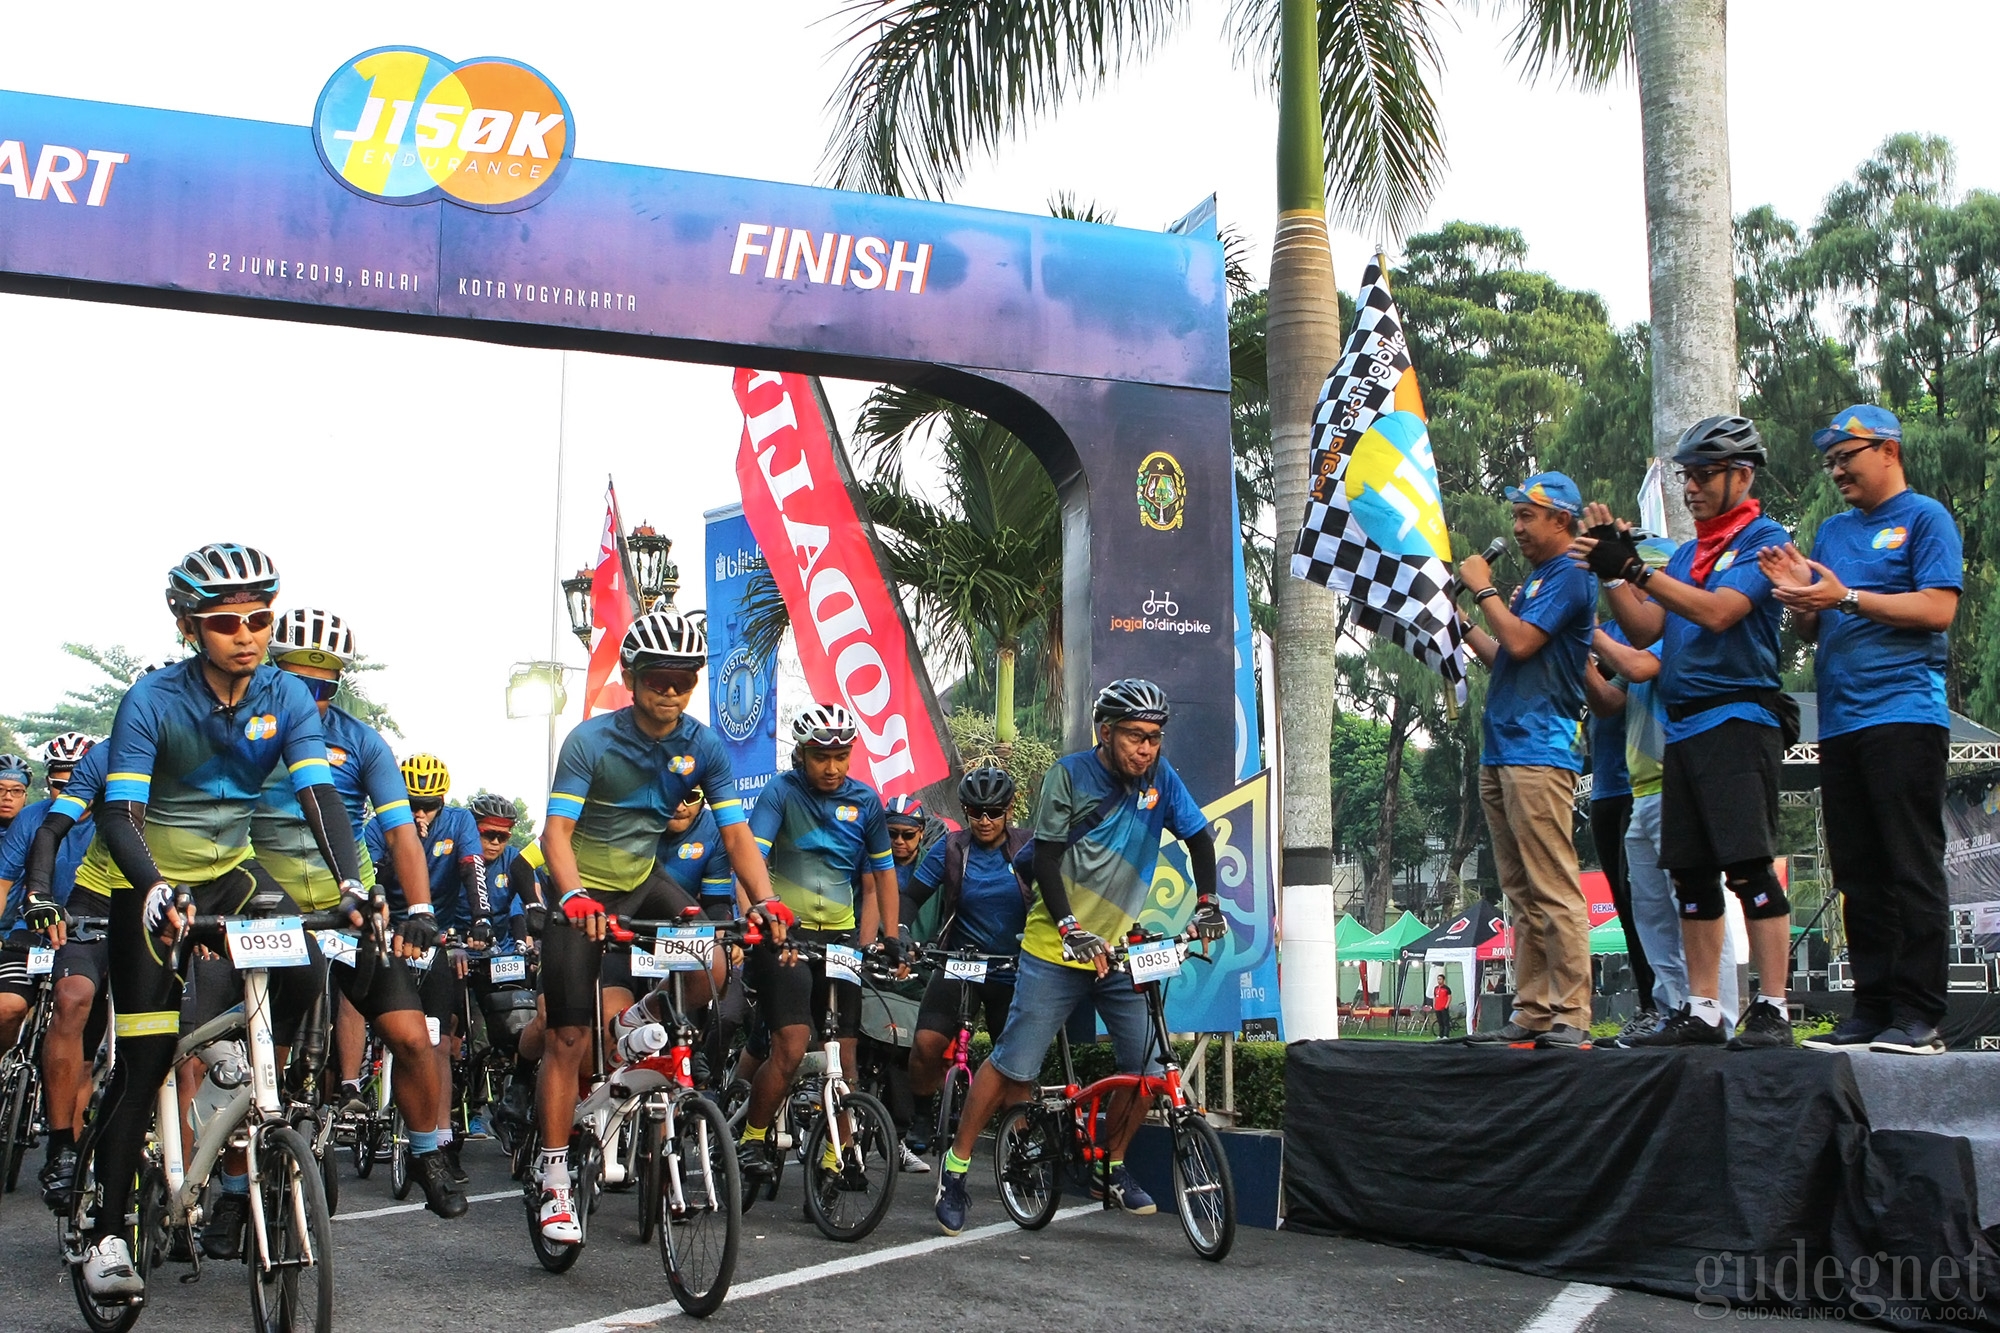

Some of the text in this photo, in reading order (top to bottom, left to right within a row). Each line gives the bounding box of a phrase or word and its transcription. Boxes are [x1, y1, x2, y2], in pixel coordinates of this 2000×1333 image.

[363, 149, 542, 179] ENDURANCE
[729, 222, 933, 295] FINISH
[208, 252, 418, 292] 22 JUNE 2019, BALAI
[459, 278, 637, 312] KOTA YOGYAKARTA
[1110, 615, 1212, 636] jogjafoldingbike
[720, 694, 762, 735] SATISFACTION
[240, 933, 292, 950] 0939
[664, 940, 705, 954] 0940
[495, 962, 520, 973] 0839
[953, 962, 981, 972] 0318
[1137, 951, 1170, 968] 0935
